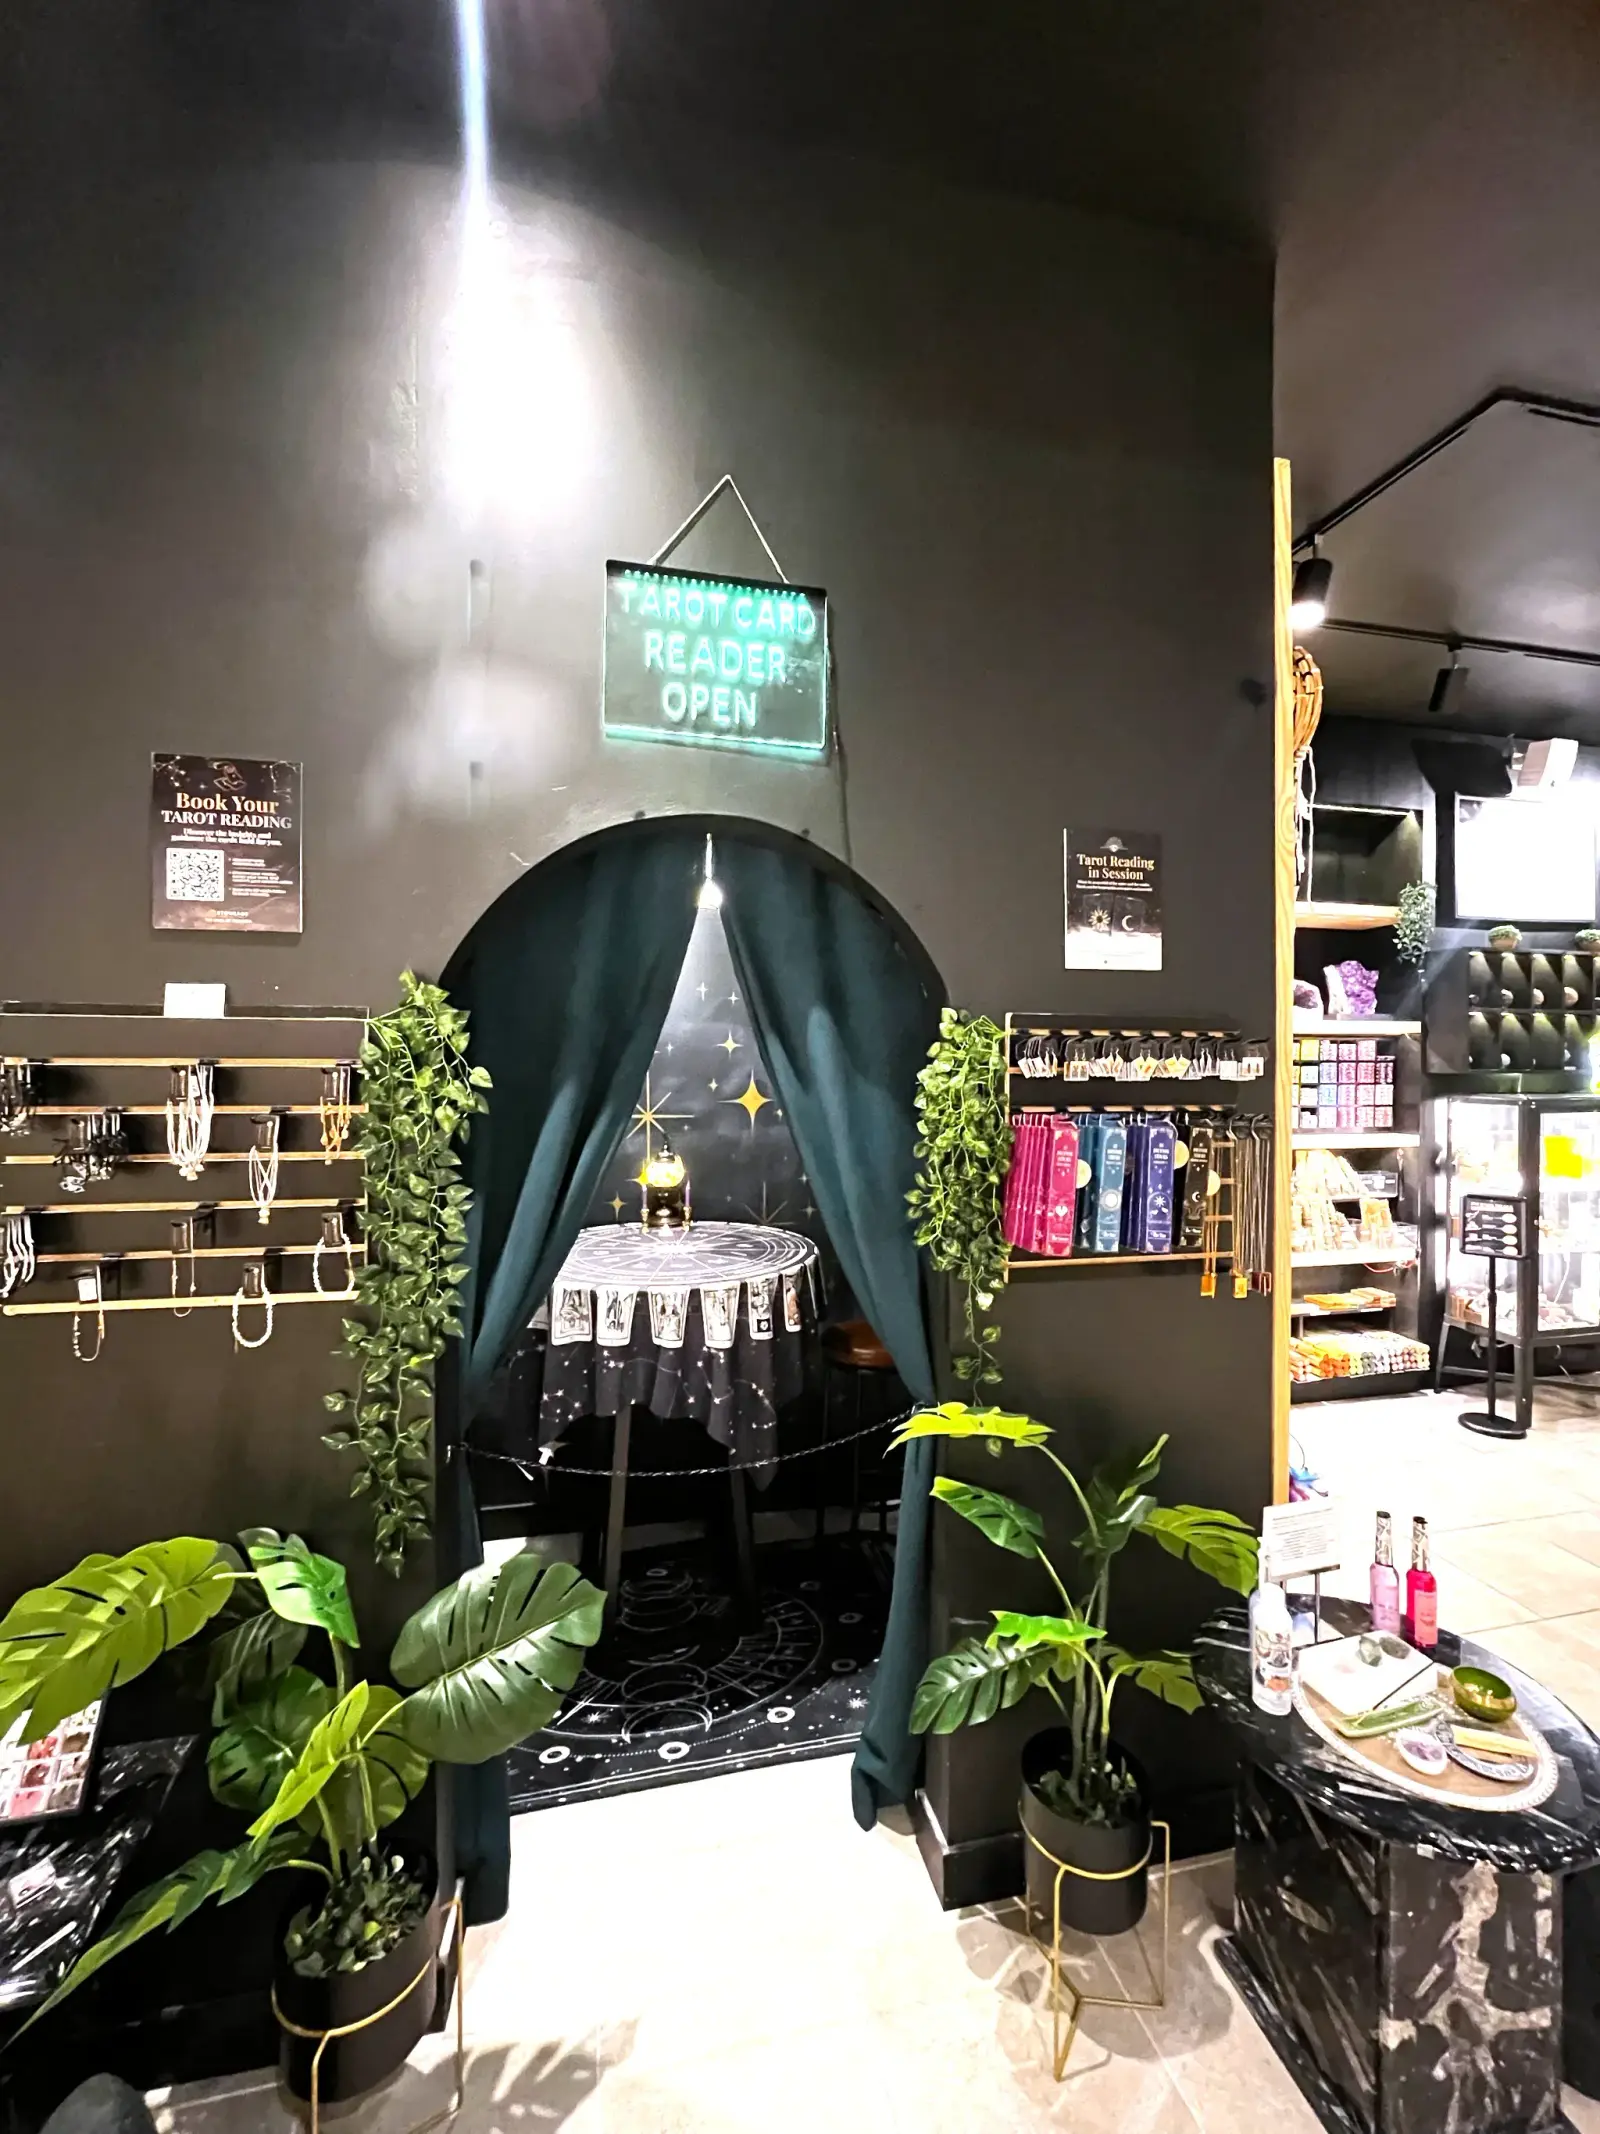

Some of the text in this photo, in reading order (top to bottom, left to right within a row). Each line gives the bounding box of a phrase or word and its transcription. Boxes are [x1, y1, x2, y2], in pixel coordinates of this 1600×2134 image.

[613, 577, 816, 636] TAROT CARD
[643, 630, 787, 683] READER
[661, 682, 757, 727] OPEN
[176, 792, 279, 814] Book Your
[161, 810, 292, 829] TAROT READING
[1076, 853, 1155, 871] Tarot Reading
[1088, 866, 1144, 880] in Session
